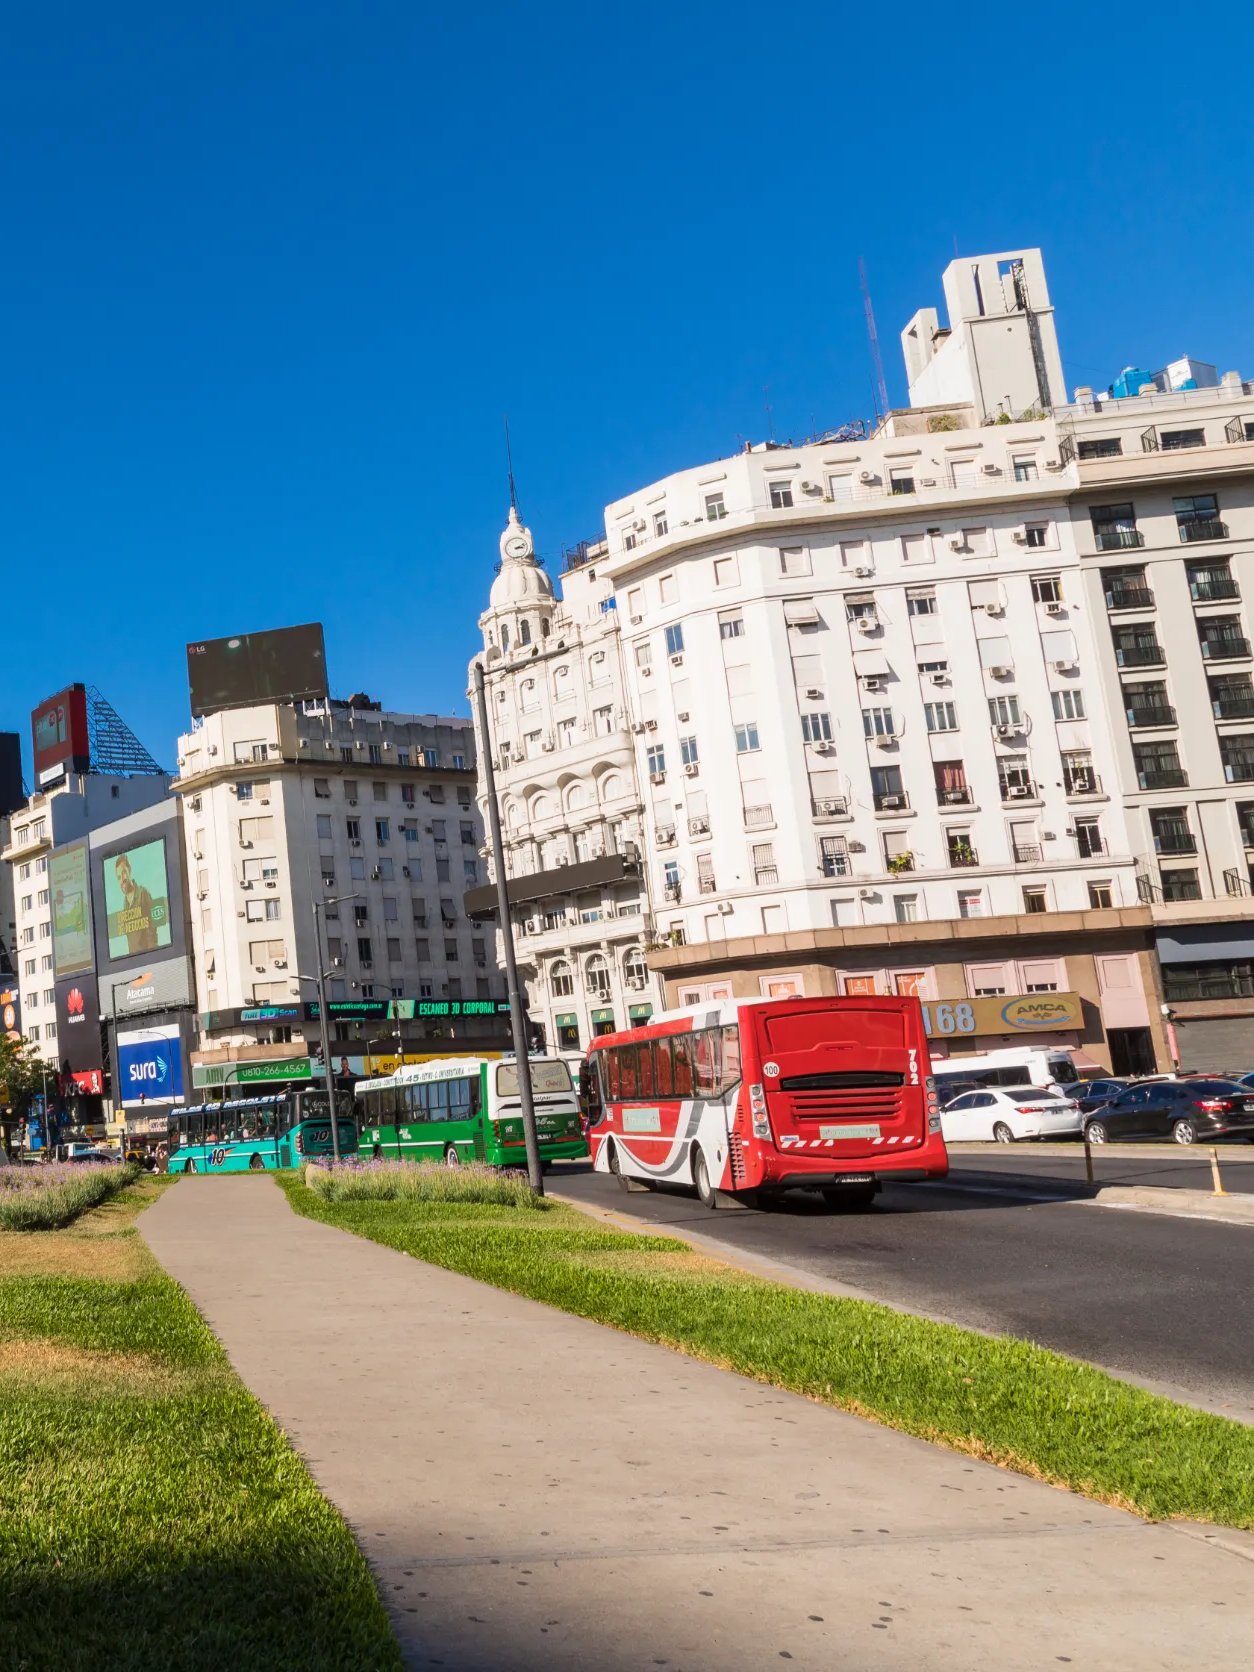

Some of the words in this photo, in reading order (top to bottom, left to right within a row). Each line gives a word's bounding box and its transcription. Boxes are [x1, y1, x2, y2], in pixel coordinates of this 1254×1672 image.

[127, 986, 154, 999] Atacama
[279, 1008, 298, 1016] Scan
[419, 1002, 448, 1015] ESCANEO
[451, 1002, 460, 1015] 3D
[463, 1002, 495, 1014] CORPORAL
[1017, 1003, 1067, 1015] AMCA
[68, 1014, 85, 1023] HUAWEI
[129, 1061, 157, 1081] sura
[242, 1064, 306, 1077] 0810-266-4567
[764, 1066, 778, 1075] 100
[908, 1049, 919, 1085] 702
[406, 1073, 419, 1082] 45
[65, 1081, 85, 1096] KFC
[313, 1130, 329, 1142] 10
[211, 1147, 226, 1166] 10
